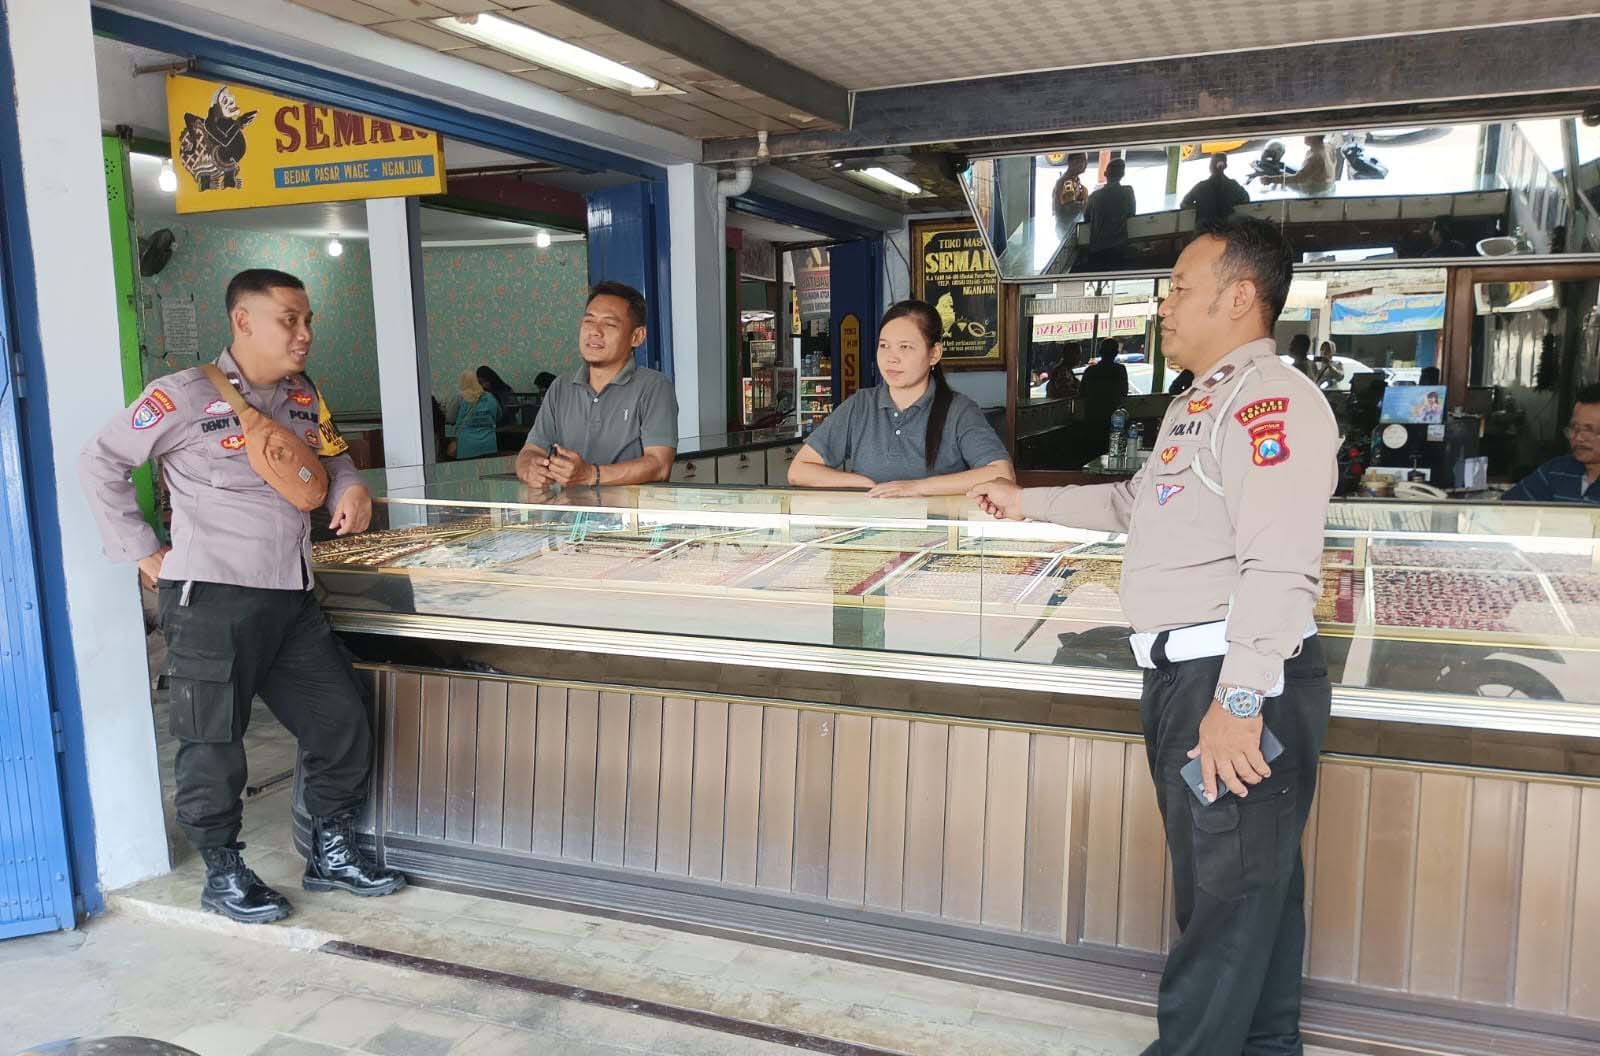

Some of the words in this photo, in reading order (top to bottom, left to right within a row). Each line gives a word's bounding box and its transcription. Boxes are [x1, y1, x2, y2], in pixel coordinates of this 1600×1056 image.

[283, 167, 310, 185] BEDAK
[314, 166, 340, 182] PASAR
[343, 162, 369, 178] WAGE
[381, 159, 424, 176] NGANJUK
[938, 239, 961, 248] TOKO
[963, 237, 983, 248] MAS
[201, 417, 230, 433] DENDY
